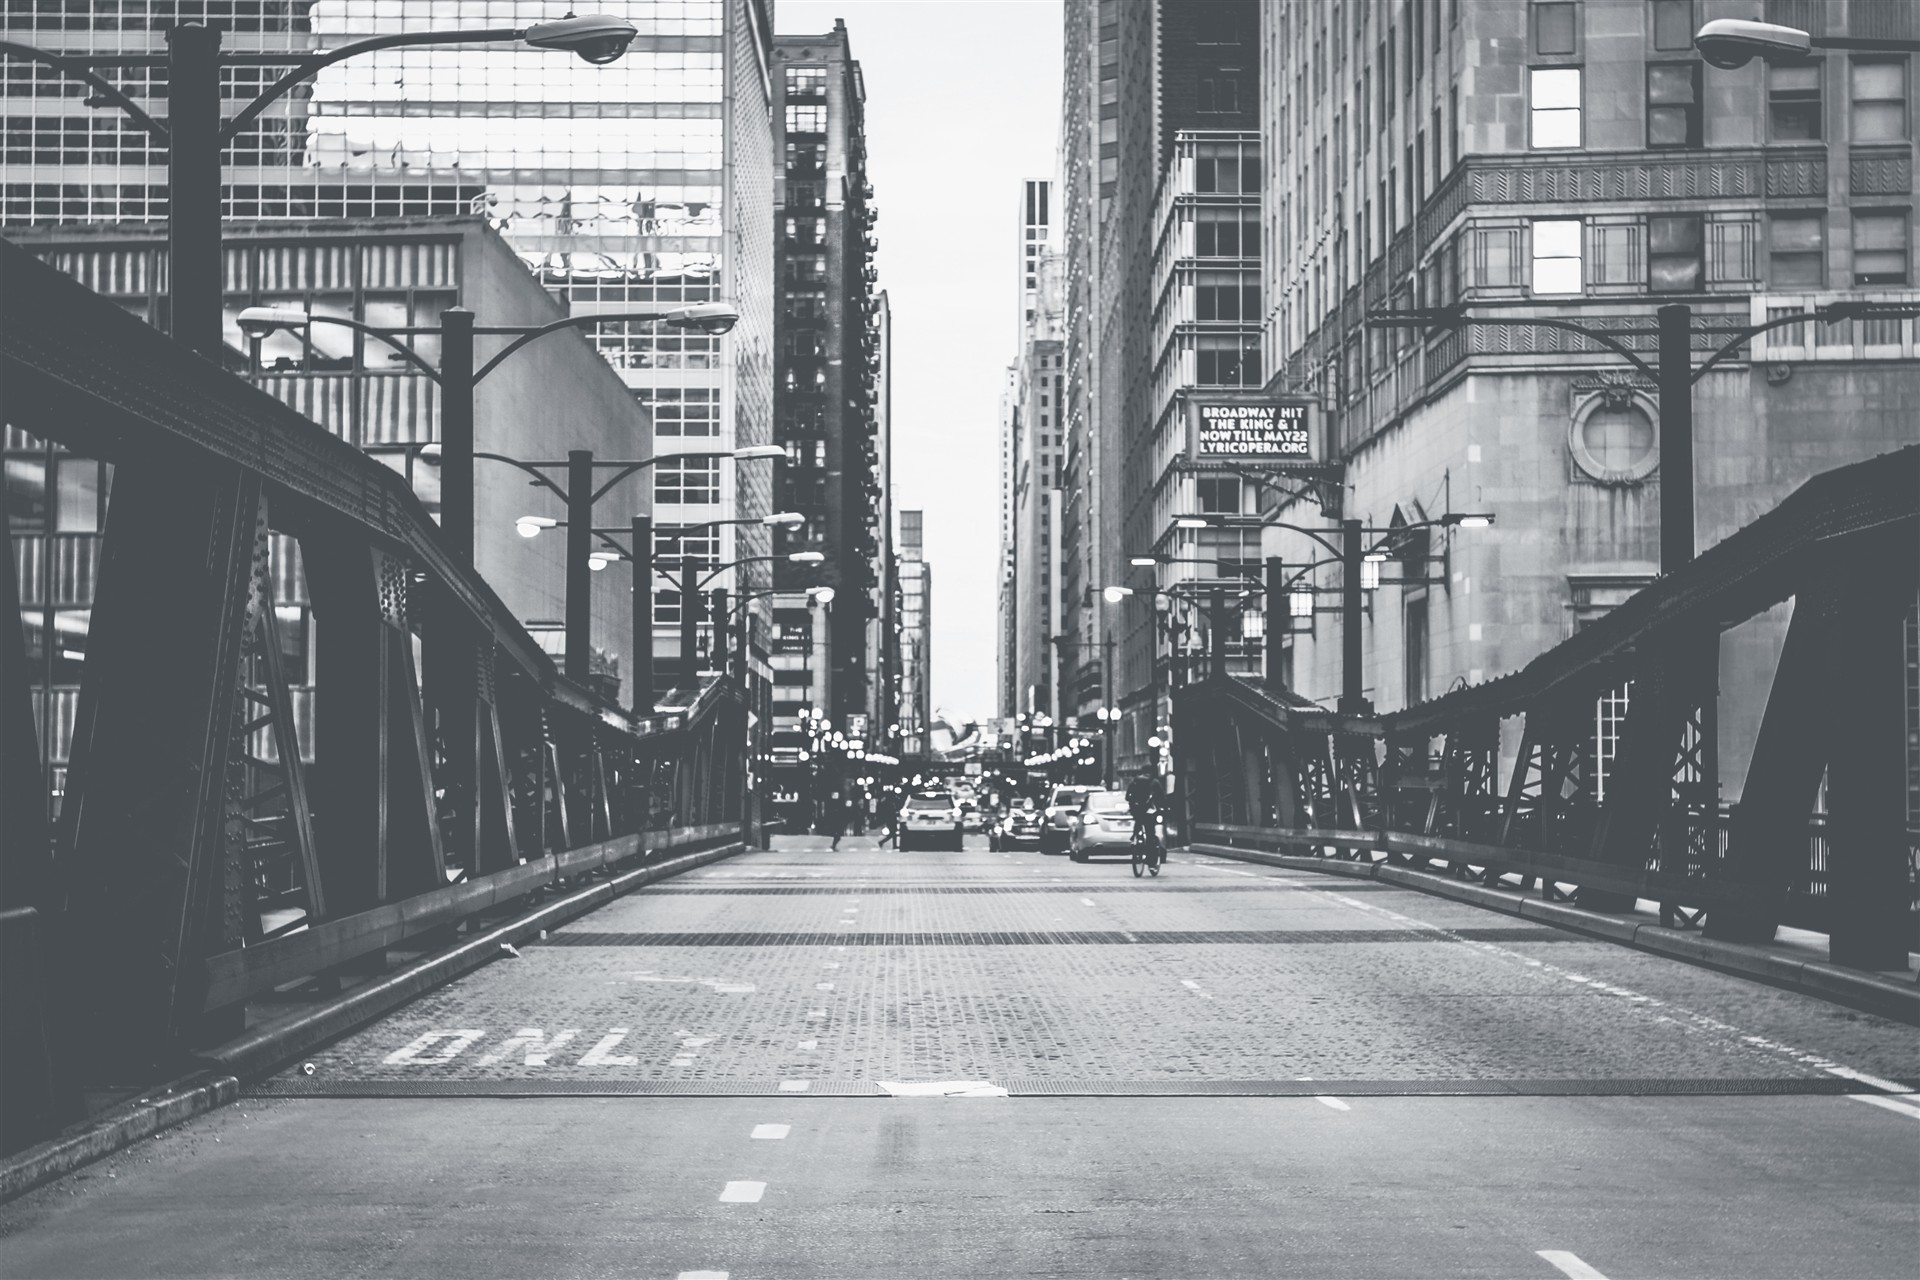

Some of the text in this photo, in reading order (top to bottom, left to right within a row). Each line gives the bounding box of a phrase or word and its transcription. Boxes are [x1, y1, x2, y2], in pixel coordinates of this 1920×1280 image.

[1202, 407, 1304, 418] BROADWAY HIT
[1209, 419, 1298, 430] THE KING & I
[1200, 430, 1231, 442] NOW
[1233, 430, 1262, 442] TILL
[1200, 442, 1308, 453] LYRICOPERA.ORG
[382, 1027, 723, 1067] ONLY
